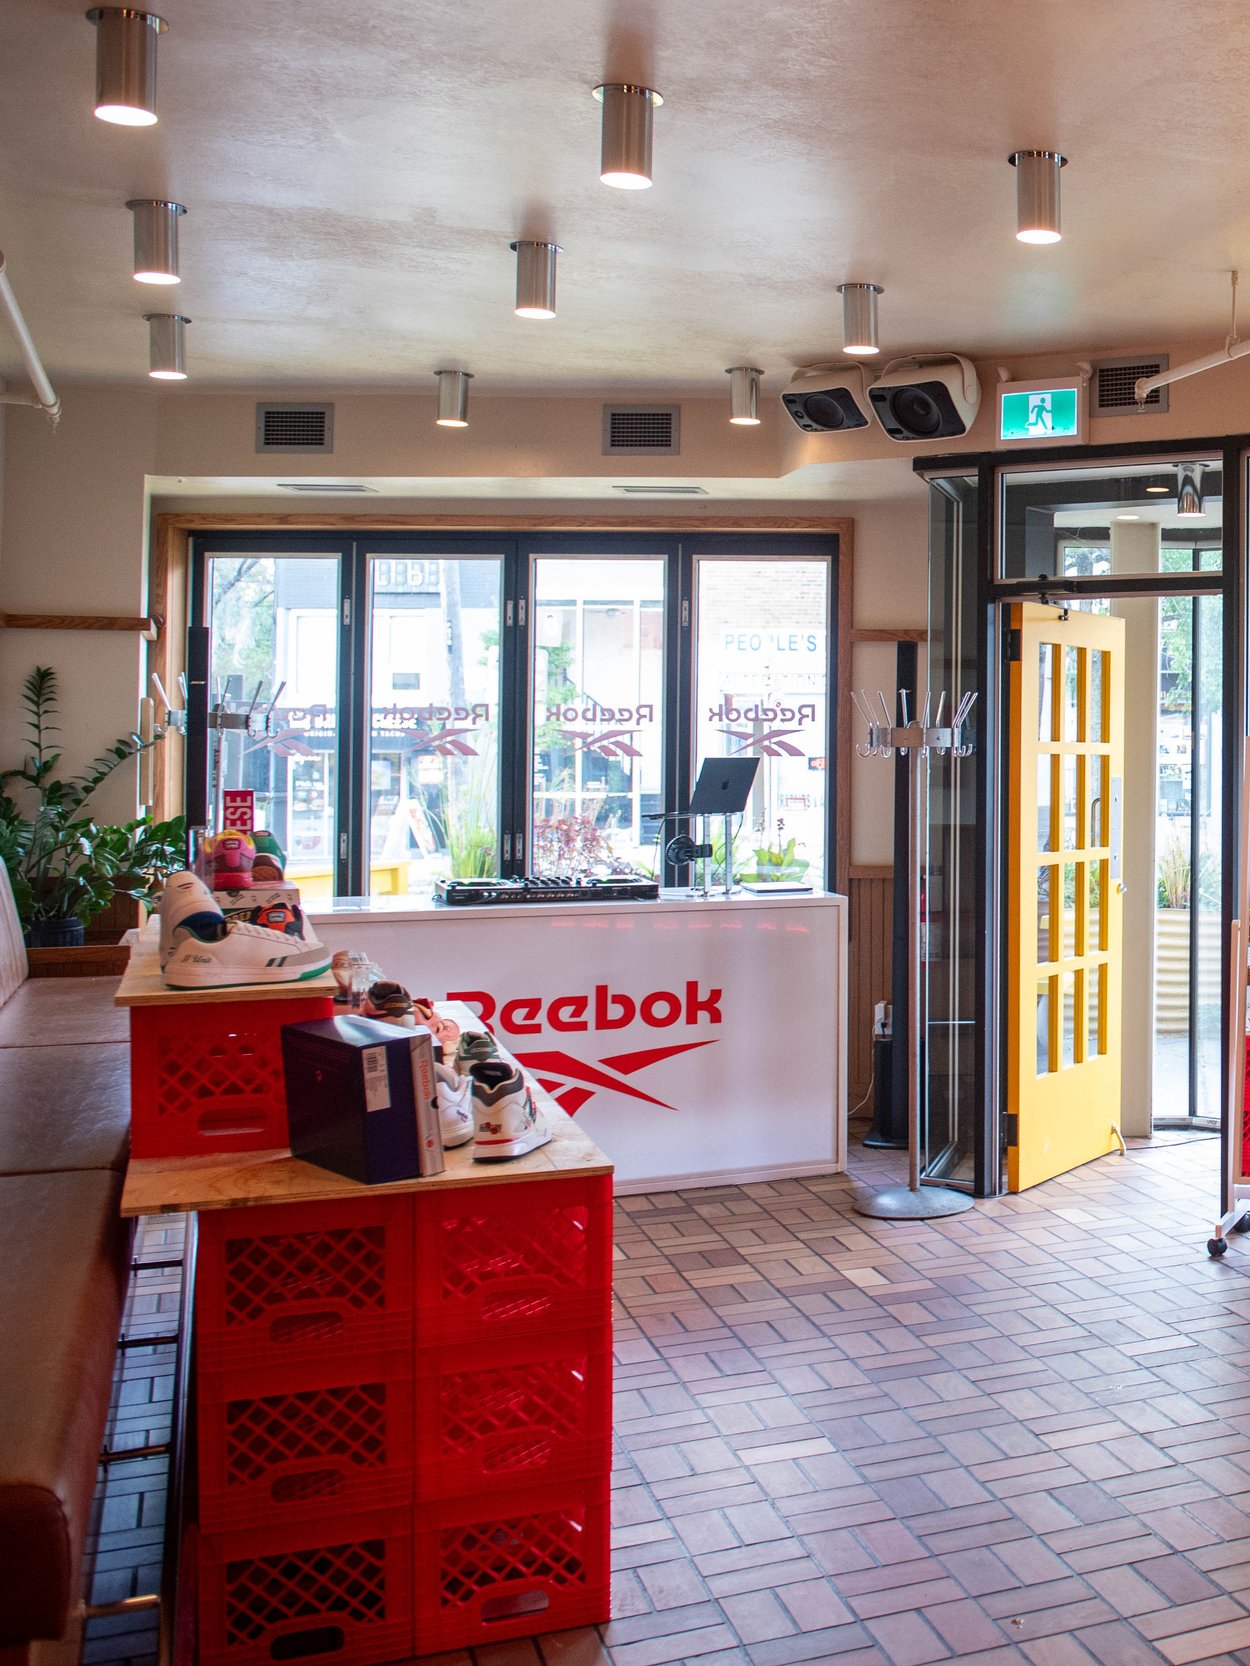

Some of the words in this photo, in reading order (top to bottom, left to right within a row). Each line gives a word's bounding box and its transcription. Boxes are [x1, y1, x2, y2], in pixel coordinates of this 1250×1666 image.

[724, 633, 818, 653] PEOLE'S
[225, 795, 252, 834] ESE
[447, 981, 723, 1035] Reebok
[420, 1060, 432, 1101] Reebok
